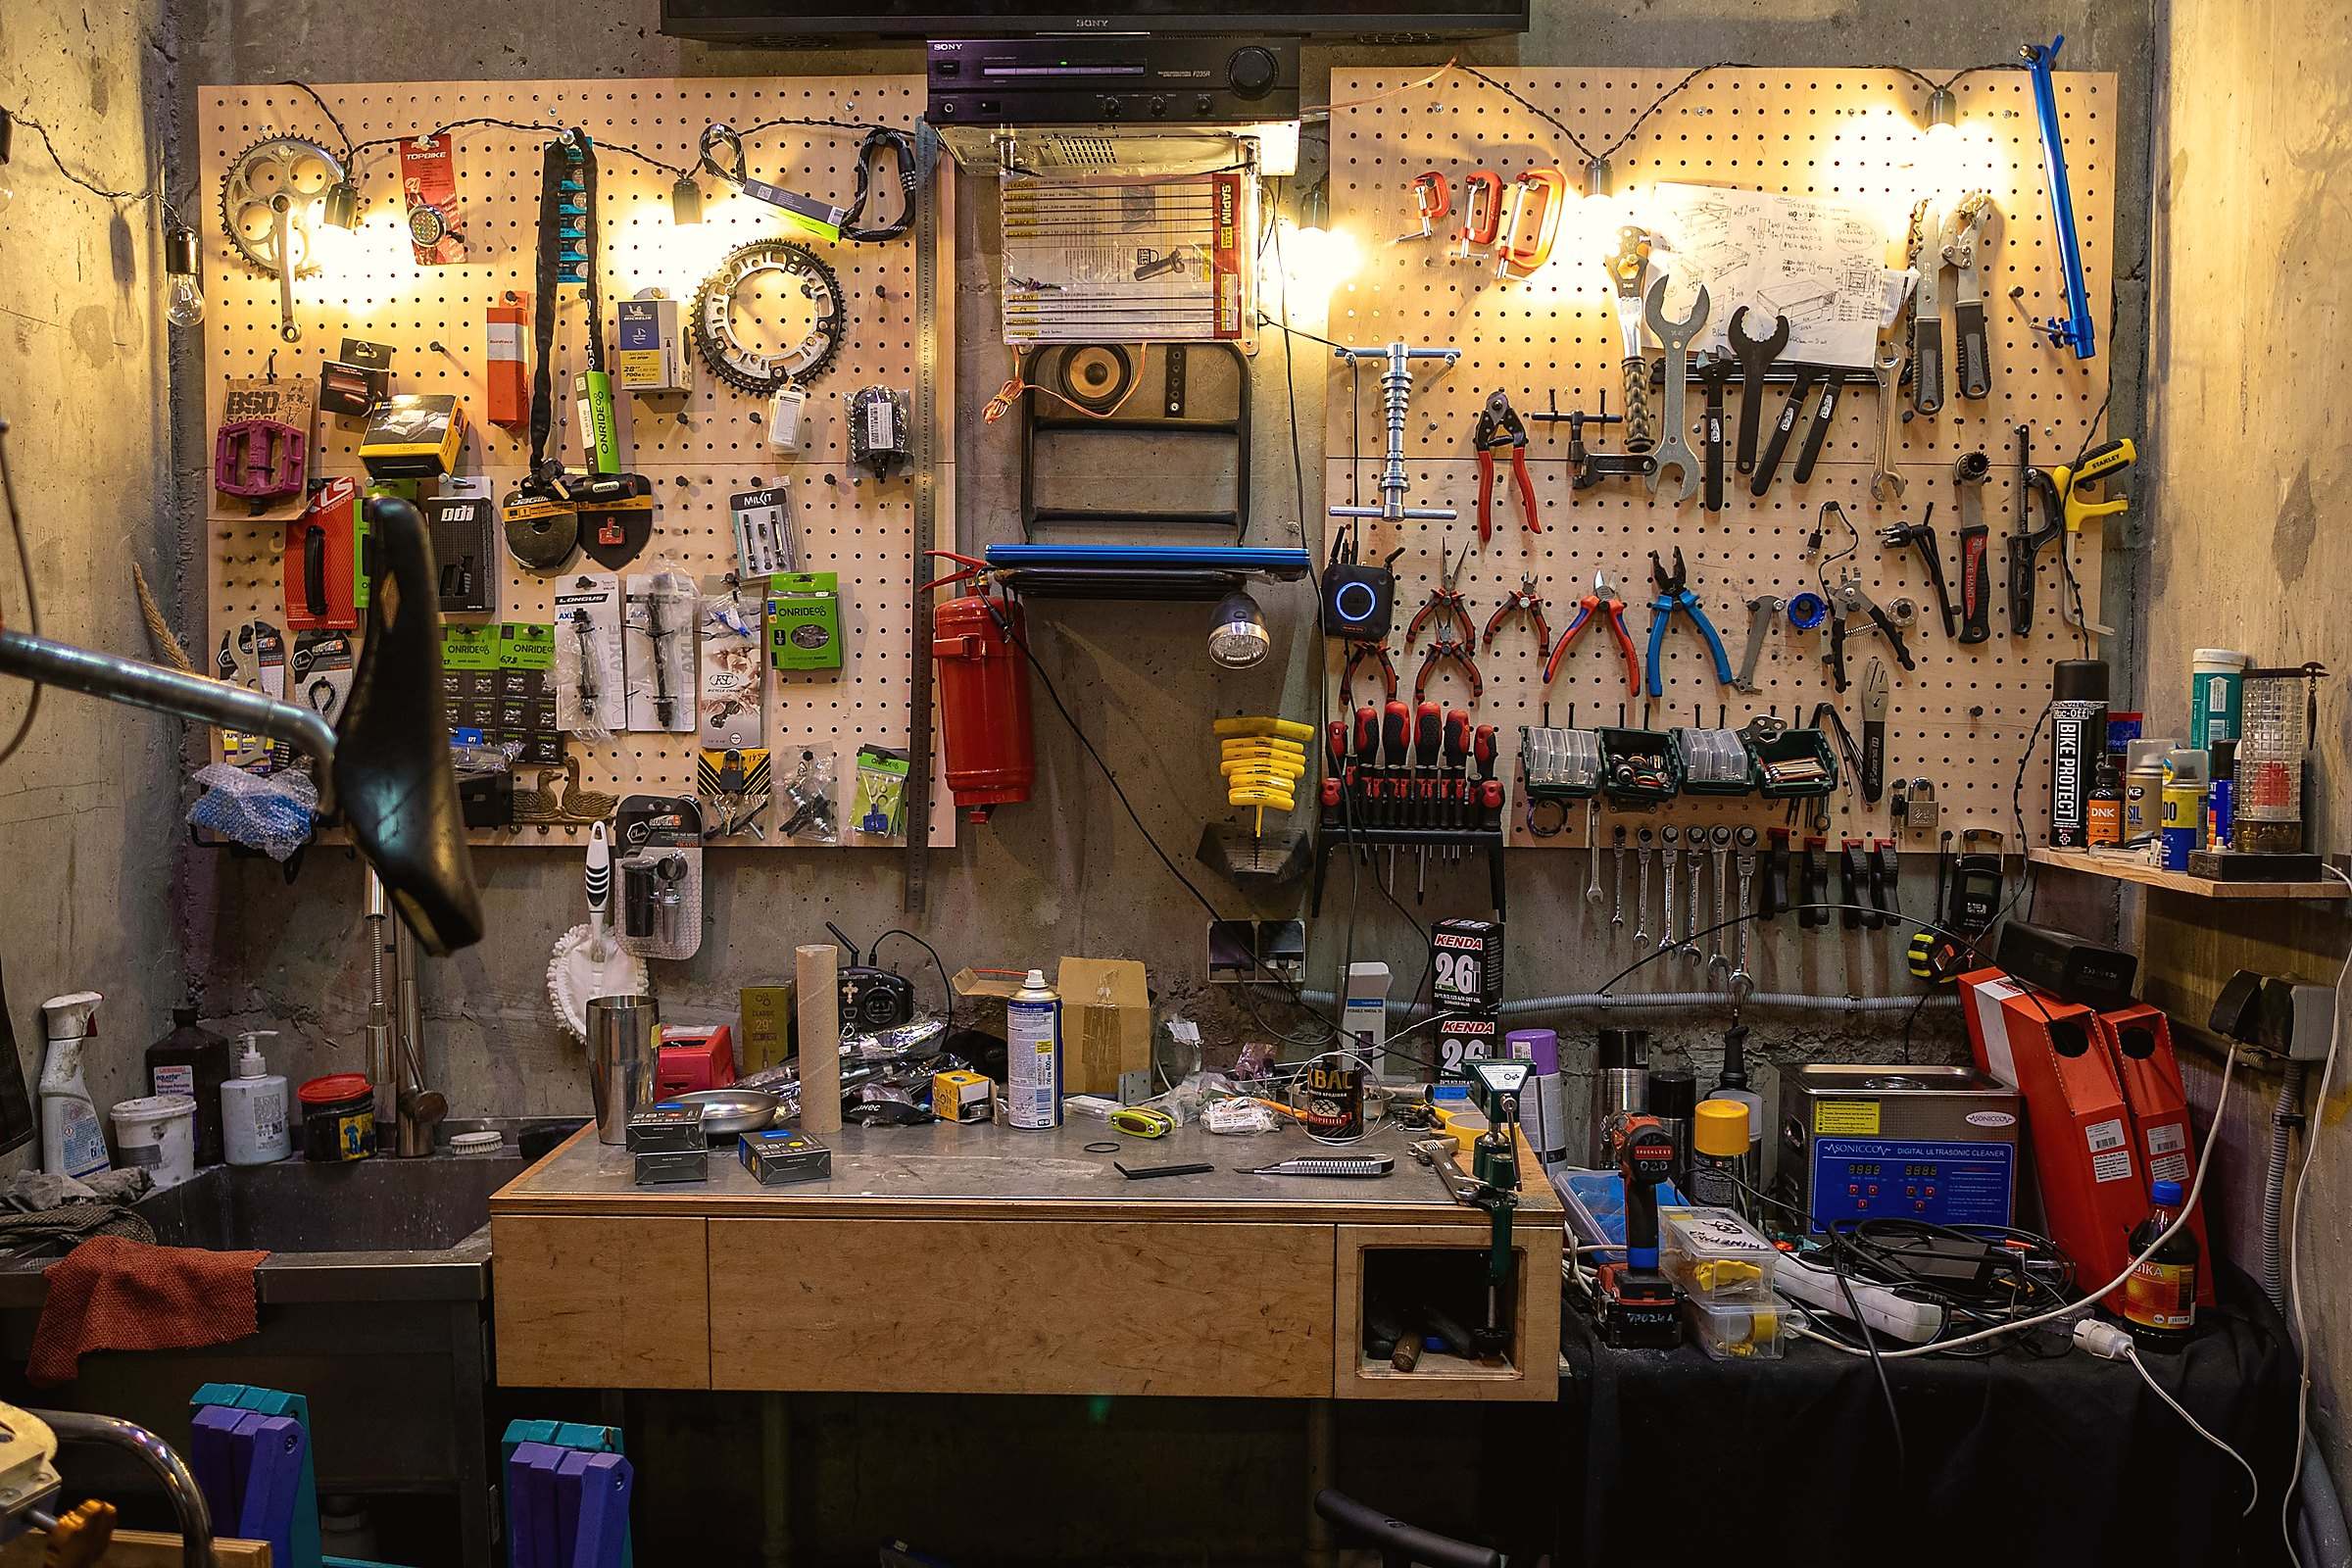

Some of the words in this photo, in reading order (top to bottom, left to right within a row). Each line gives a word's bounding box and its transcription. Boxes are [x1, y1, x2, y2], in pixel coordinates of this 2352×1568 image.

[1076, 19, 1108, 27] SONY
[406, 151, 447, 161] TOPBIKE
[1221, 184, 1232, 224] SAPIM
[226, 391, 280, 415] BSD
[597, 405, 609, 455] ONRIDE
[2091, 454, 2121, 469] STANLEY
[778, 607, 815, 617] ONRIDE
[448, 645, 481, 655] ONRIDE
[514, 644, 549, 655] ONRIDE
[608, 624, 622, 673] AXLE
[2059, 724, 2077, 756] BIKE
[2057, 758, 2076, 818] PROTECT
[2129, 788, 2141, 797] K2
[2090, 808, 2115, 817] DNK
[2128, 805, 2143, 820] SIL
[1434, 933, 1483, 951] KENDA
[1441, 1020, 1494, 1034] KENDA
